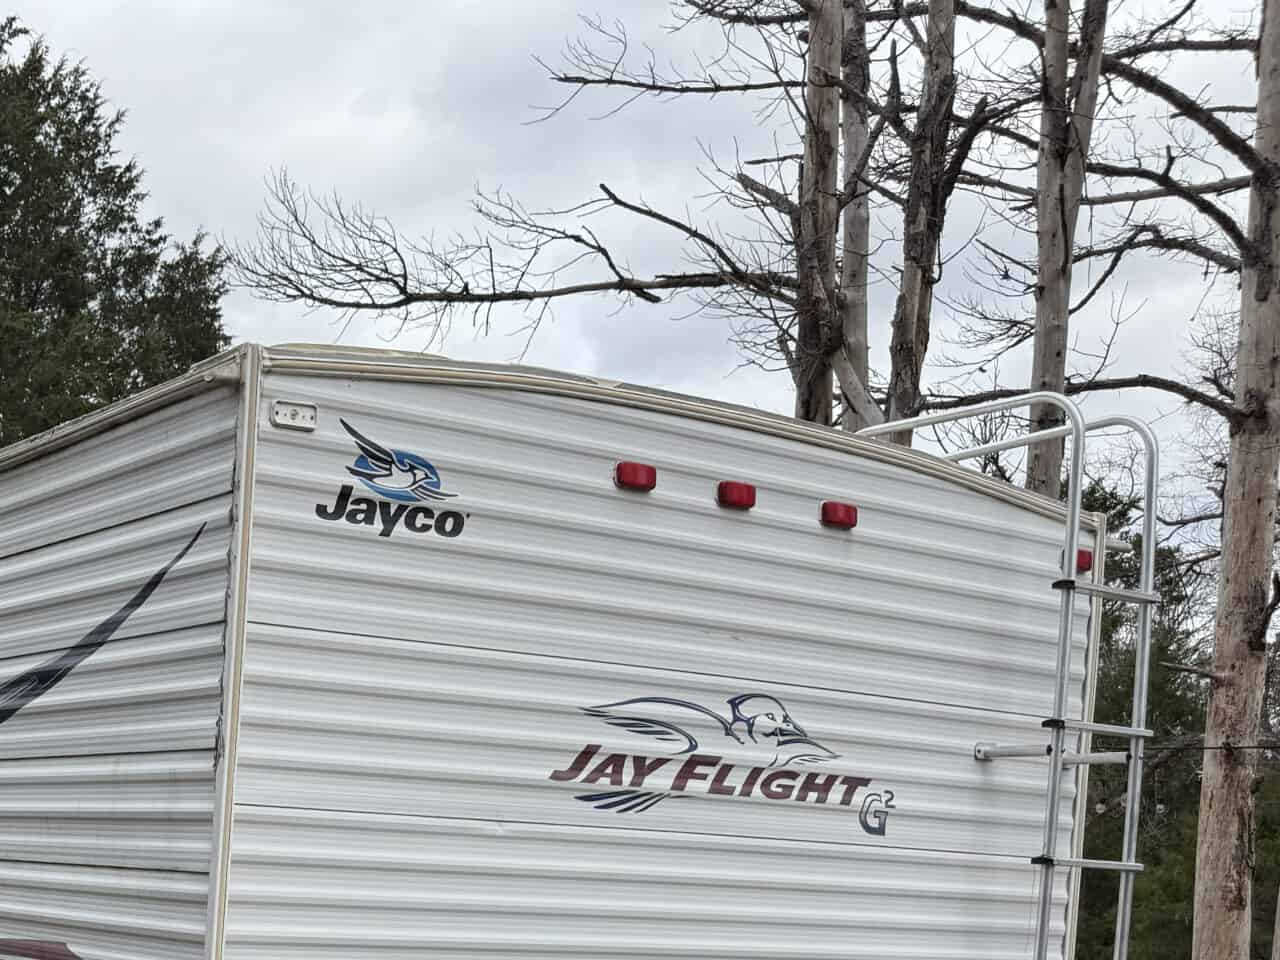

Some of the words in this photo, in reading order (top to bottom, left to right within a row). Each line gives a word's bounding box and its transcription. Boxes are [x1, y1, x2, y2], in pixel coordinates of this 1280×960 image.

[315, 484, 465, 538] Jayco
[549, 744, 671, 787] JAY
[670, 754, 872, 806] FLIGHT
